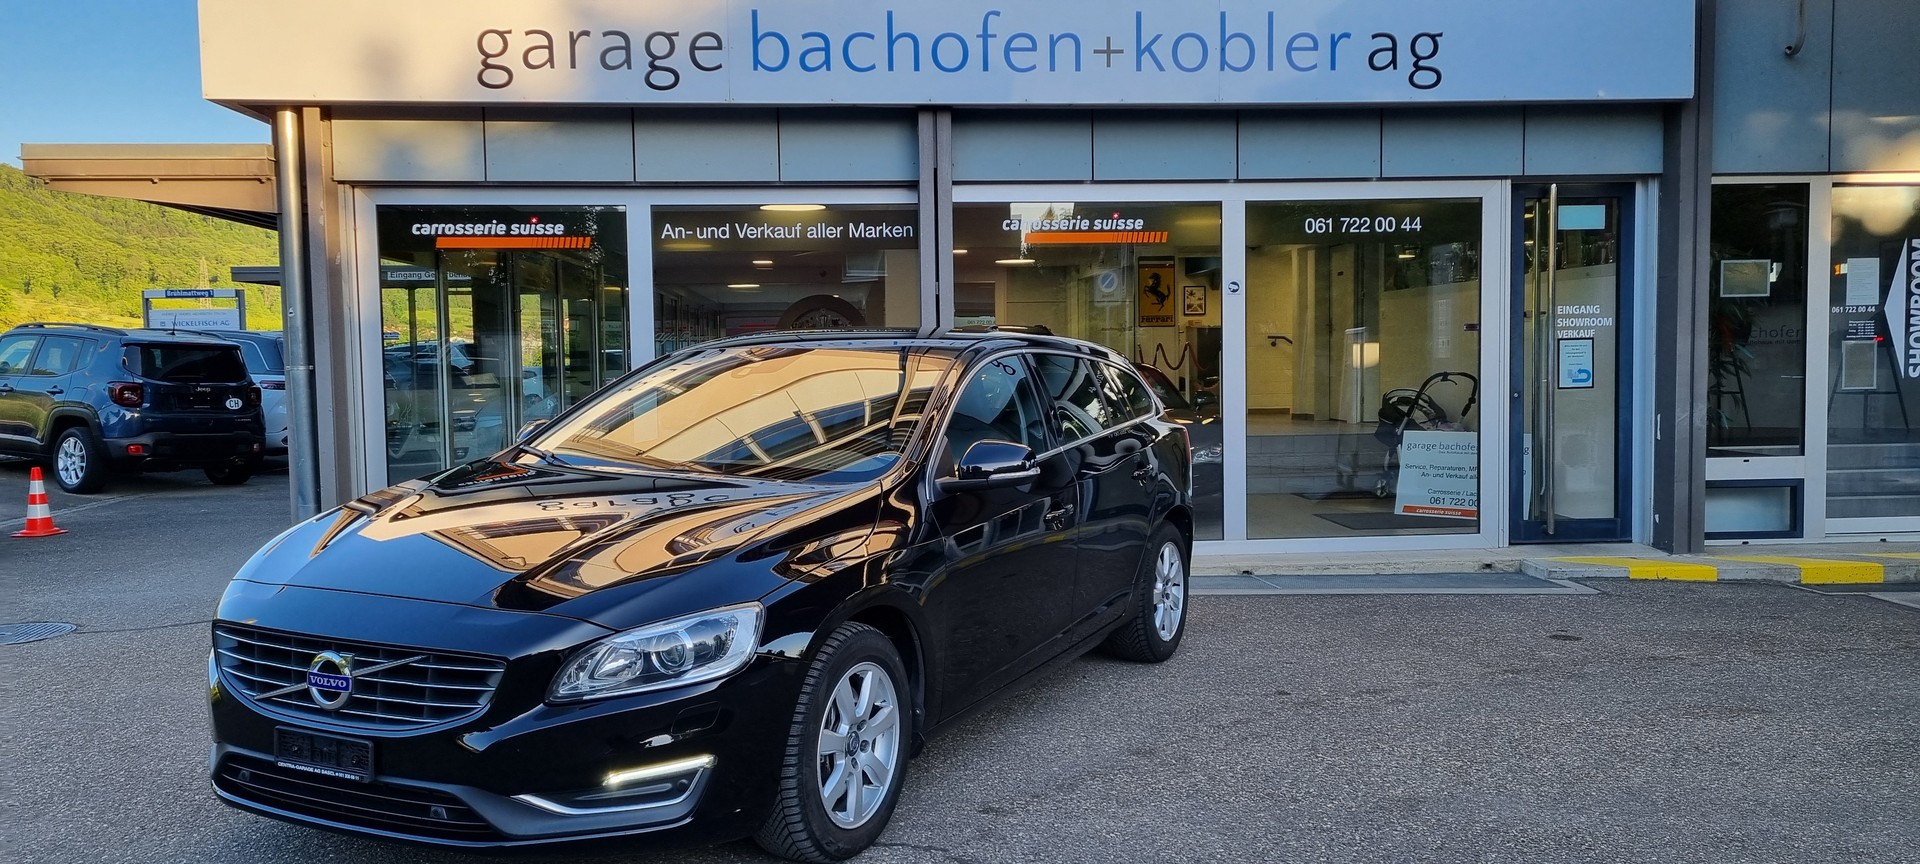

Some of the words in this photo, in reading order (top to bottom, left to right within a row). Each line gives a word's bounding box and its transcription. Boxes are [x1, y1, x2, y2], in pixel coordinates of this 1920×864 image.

[477, 28, 723, 91] garage
[1367, 31, 1443, 90] ag
[411, 219, 506, 235] carrosserie
[510, 221, 564, 235] suisse
[1002, 214, 1089, 231] carrosserie
[1093, 215, 1144, 231] suisse
[1304, 217, 1334, 234] 061
[1340, 217, 1371, 233] 722
[1374, 216, 1396, 232] 00
[1401, 216, 1422, 232] 44
[661, 223, 693, 239] An-
[697, 223, 730, 239] und
[735, 222, 802, 239] Verkauf
[806, 222, 843, 239] aller
[848, 222, 913, 238] Marken
[389, 270, 422, 280] Eingang
[166, 289, 209, 298] Brühlmattweg
[1557, 305, 1600, 315] EINGANG
[1832, 306, 1843, 314] 061
[1844, 305, 1856, 314] 722
[1857, 305, 1866, 313] 00
[1867, 305, 1876, 313] 44
[220, 319, 230, 327] AG
[1557, 317, 1613, 328] SHOWROOM
[1557, 329, 1596, 338] VERKAUF
[229, 400, 239, 408] CH
[1406, 442, 1437, 451] garage
[1405, 463, 1428, 471] Service,
[1429, 464, 1468, 472] Reparaturen,
[1427, 488, 1461, 496] Carrosserie
[1429, 496, 1446, 505] 061
[1449, 497, 1466, 507] 722
[1416, 507, 1444, 515] carrosserie
[1445, 508, 1462, 516] suisse
[310, 675, 347, 688] VOLVO
